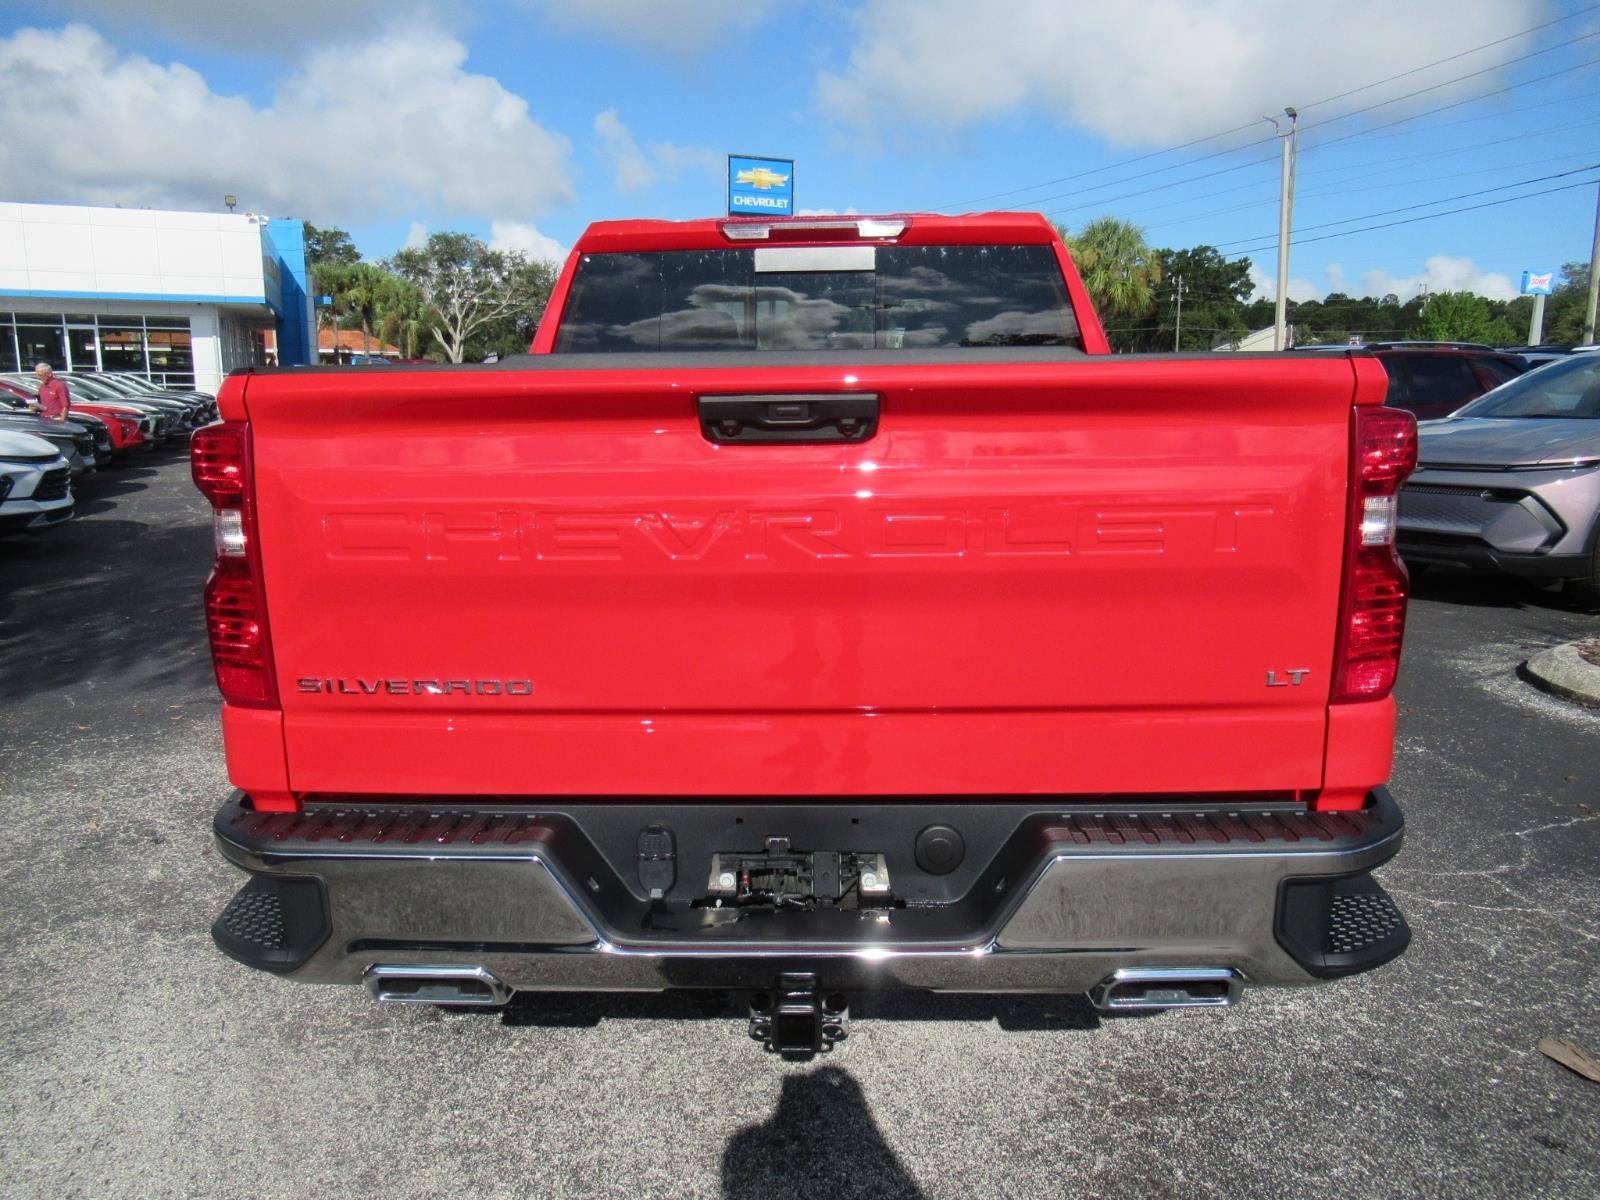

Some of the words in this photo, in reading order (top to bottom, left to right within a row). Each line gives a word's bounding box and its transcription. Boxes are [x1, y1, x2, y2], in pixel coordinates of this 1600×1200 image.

[734, 196, 789, 209] CHEVROLET
[321, 503, 1274, 561] CHEVROLET
[297, 678, 533, 696] SILVERADO
[1266, 669, 1310, 688] LT
